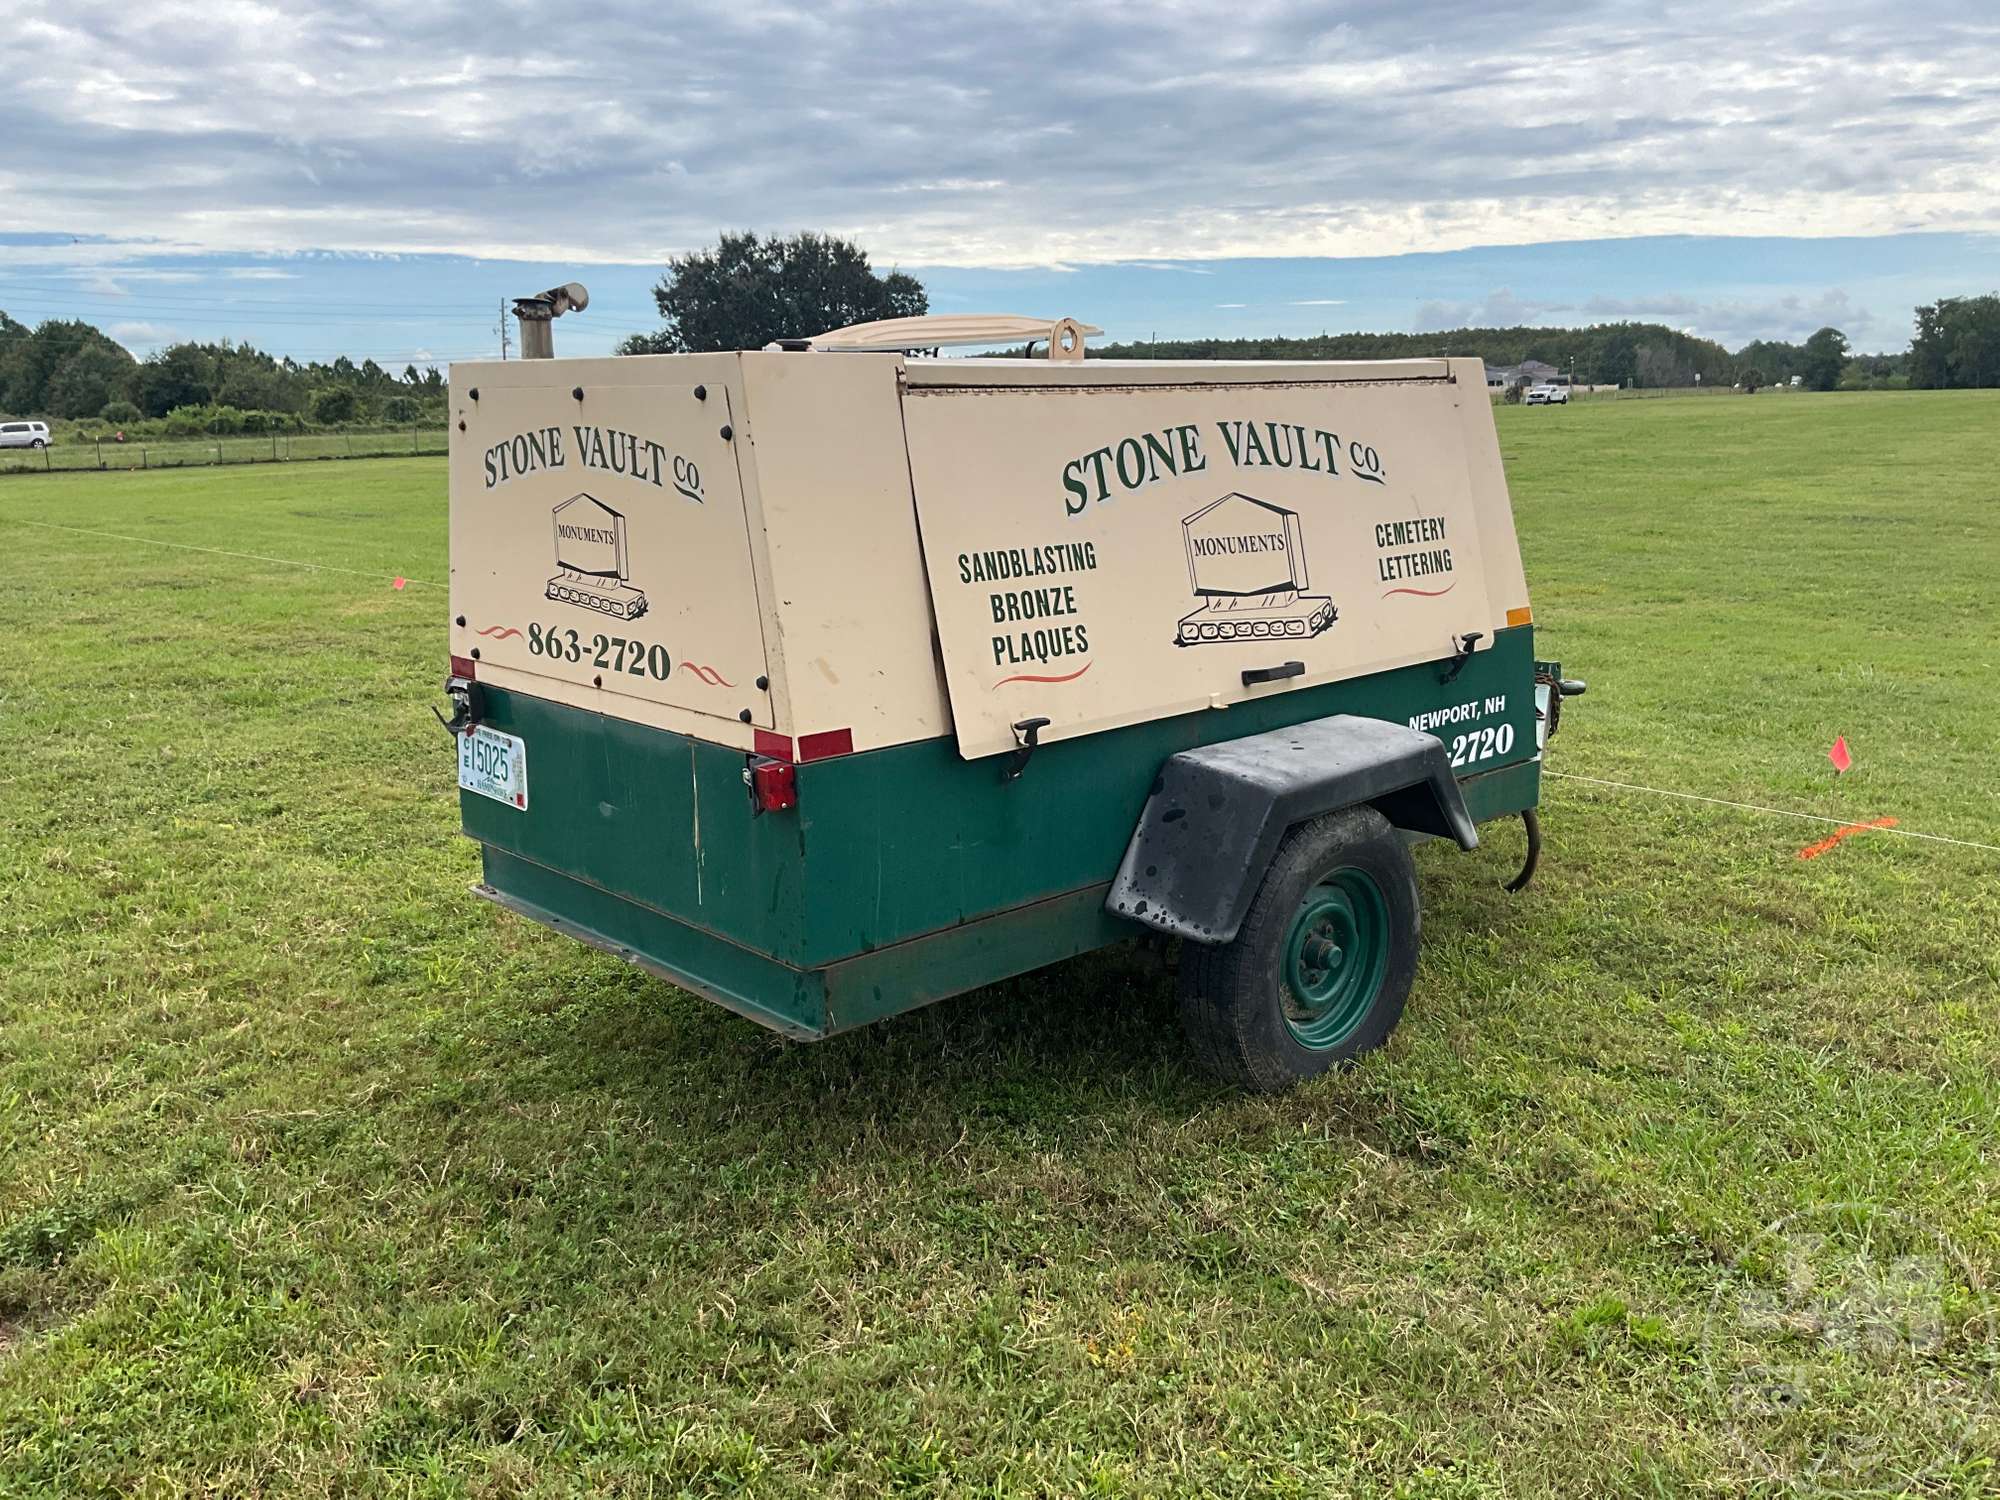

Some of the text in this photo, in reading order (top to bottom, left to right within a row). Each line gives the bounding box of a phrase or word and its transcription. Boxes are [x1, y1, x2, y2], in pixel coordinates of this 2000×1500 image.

[484, 426, 705, 496] STONE VAULT CO.
[1062, 420, 1386, 516] STONE VAULT CO.
[557, 524, 615, 545] MONUMENTS
[1192, 533, 1286, 556] MONUMENTS
[1375, 516, 1446, 548] CEMETERY
[958, 541, 1097, 584] SANDBLASTING
[1378, 549, 1453, 581] LETTERING
[990, 586, 1077, 623] BRONZE
[528, 622, 671, 681] 863-2720
[992, 624, 1089, 666] PLAQUES
[1409, 695, 1506, 731] NEWPORT, NH
[471, 737, 509, 782] 15025
